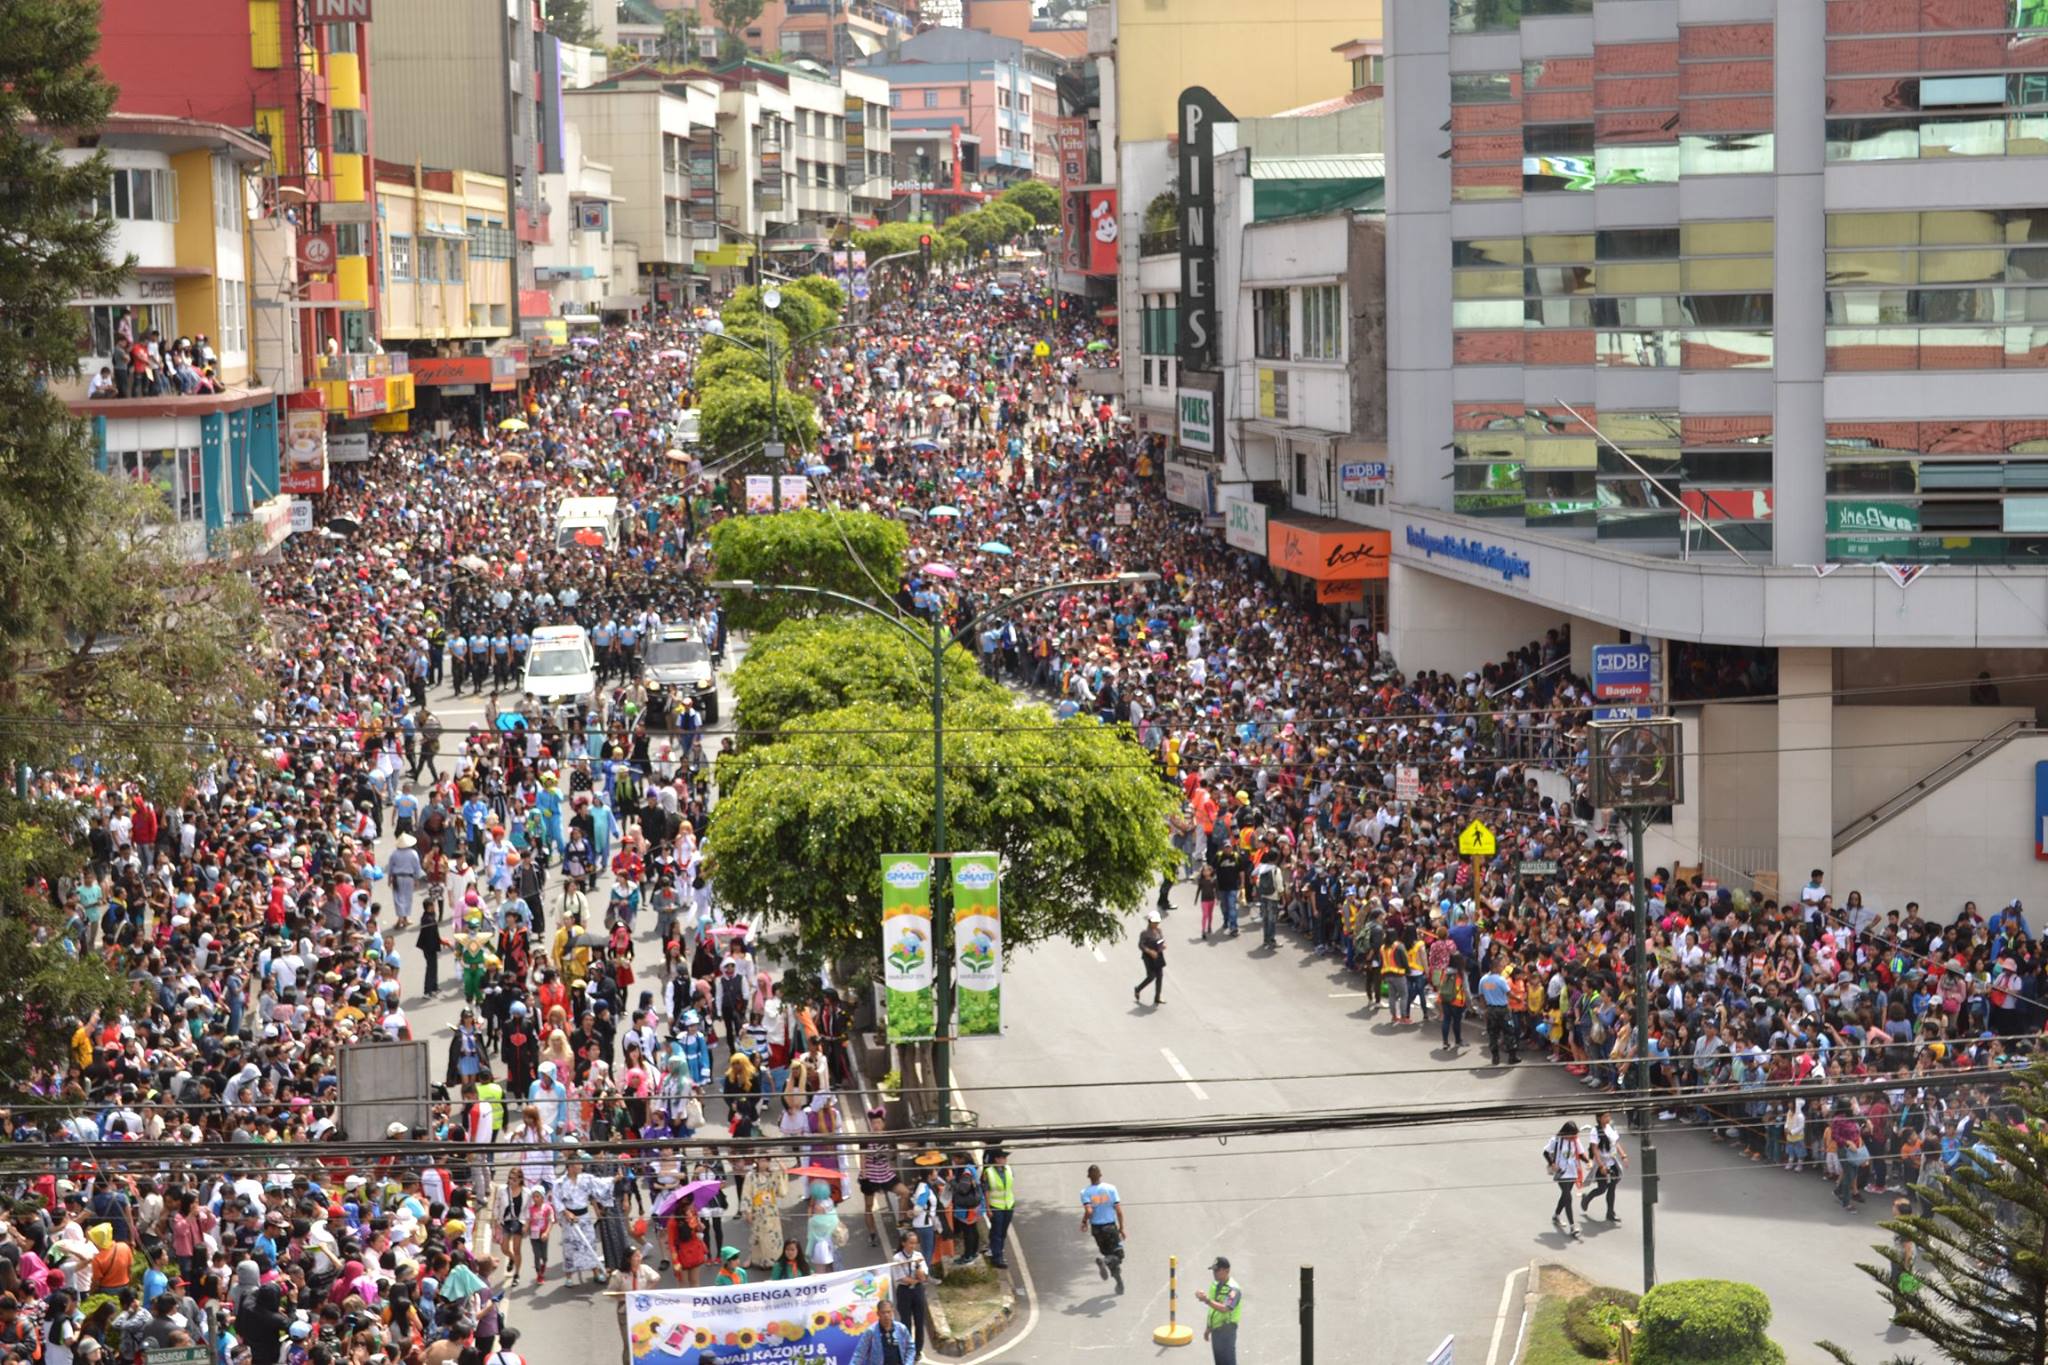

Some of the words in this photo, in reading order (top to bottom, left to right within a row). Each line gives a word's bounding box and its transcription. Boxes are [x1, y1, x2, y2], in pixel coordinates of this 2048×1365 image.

[316, 0, 367, 16] INN
[1185, 104, 1207, 349] PINES
[1181, 396, 1210, 427] PINES
[1356, 464, 1382, 477] DBP
[1230, 503, 1249, 531] JRS
[1613, 653, 1650, 670] DBP
[1605, 686, 1642, 696] Baguio
[1608, 708, 1638, 719] ATM
[887, 871, 926, 881] SMART
[957, 873, 996, 882] SMART
[693, 1289, 791, 1308] PANAGBENGA
[795, 1284, 827, 1297] 2016
[773, 1301, 793, 1310] with
[752, 1344, 814, 1360] KAZOKU
[816, 1343, 828, 1354] &
